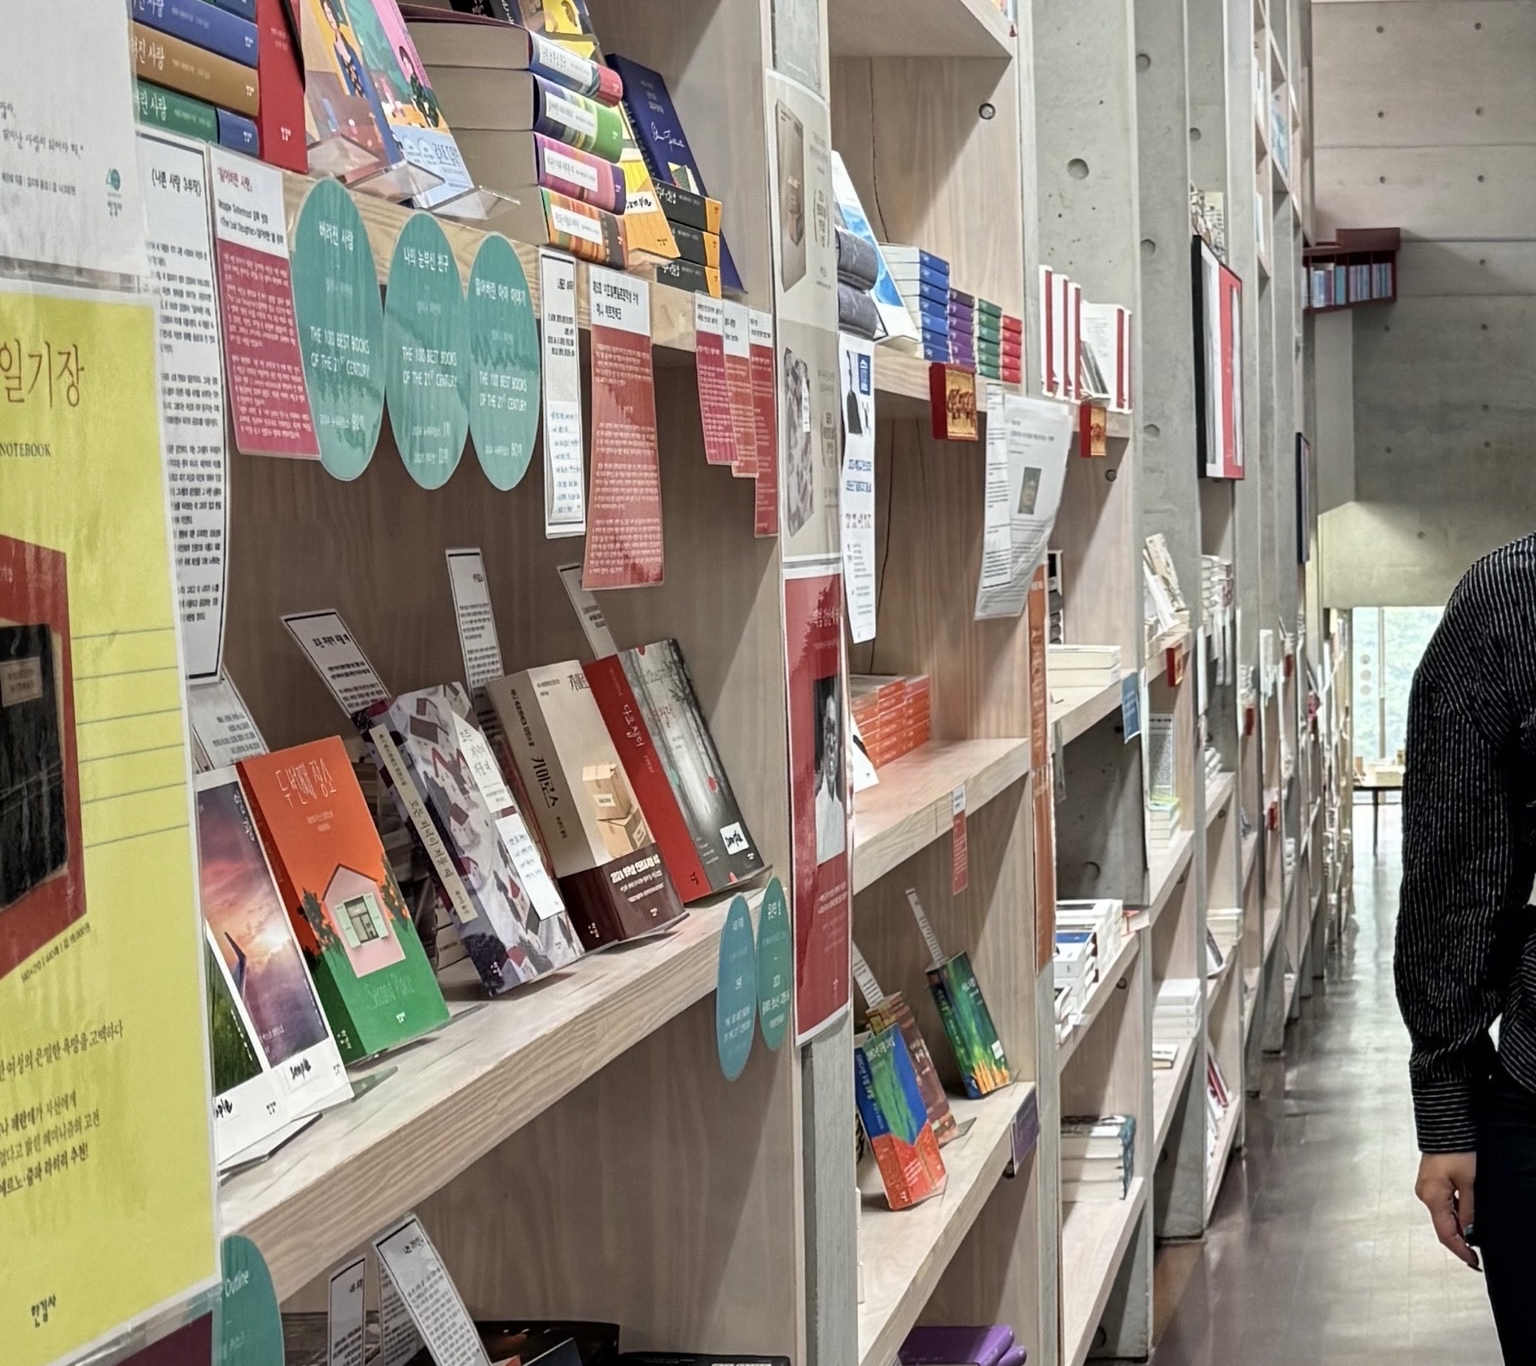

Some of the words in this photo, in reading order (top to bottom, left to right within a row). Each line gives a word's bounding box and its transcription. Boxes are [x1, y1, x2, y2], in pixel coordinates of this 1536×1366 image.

[148, 42, 166, 71] 사랑
[149, 95, 168, 122] 사랑
[341, 227, 354, 251] 사랑
[403, 247, 417, 267] 나의
[417, 251, 436, 271] 눈부신
[437, 255, 449, 274] 친구
[309, 326, 323, 341] THE
[323, 328, 334, 345] 100
[335, 331, 350, 348] BEST
[350, 335, 370, 354] BOOKS
[310, 353, 319, 368] OF
[319, 356, 332, 371] THE
[346, 359, 370, 378] CENTURY
[402, 346, 414, 362] THE
[414, 348, 426, 363] 100
[426, 349, 440, 365] BEST
[440, 351, 457, 366] BOOKS
[0, 338, 85, 408] 일기장
[402, 371, 411, 385] OF
[411, 372, 423, 386] THE
[436, 372, 458, 389] CENTURY
[479, 371, 490, 385] THE
[490, 372, 500, 386] 100
[500, 373, 511, 389] BEST
[511, 376, 527, 392] BOOKS
[479, 393, 488, 406] OF
[488, 394, 497, 407] THE
[507, 396, 528, 413] CENTURY
[0, 442, 51, 457] NOTEBOOK
[532, 756, 560, 810] 카이로스
[6, 1051, 35, 1078] 여성의
[35, 1042, 62, 1069] 은밀한
[62, 1030, 89, 1059] 욕망을
[89, 1019, 124, 1052] 고백하다
[10, 1099, 44, 1133] 페란테가
[44, 1090, 78, 1121] 자신에게
[41, 1118, 83, 1155] 페미니즘의
[83, 1106, 101, 1138] 고전
[43, 1150, 69, 1182] 라히리
[69, 1141, 89, 1170] 추천!
[224, 1268, 250, 1299] Outline
[31, 1294, 57, 1328] 한길사
